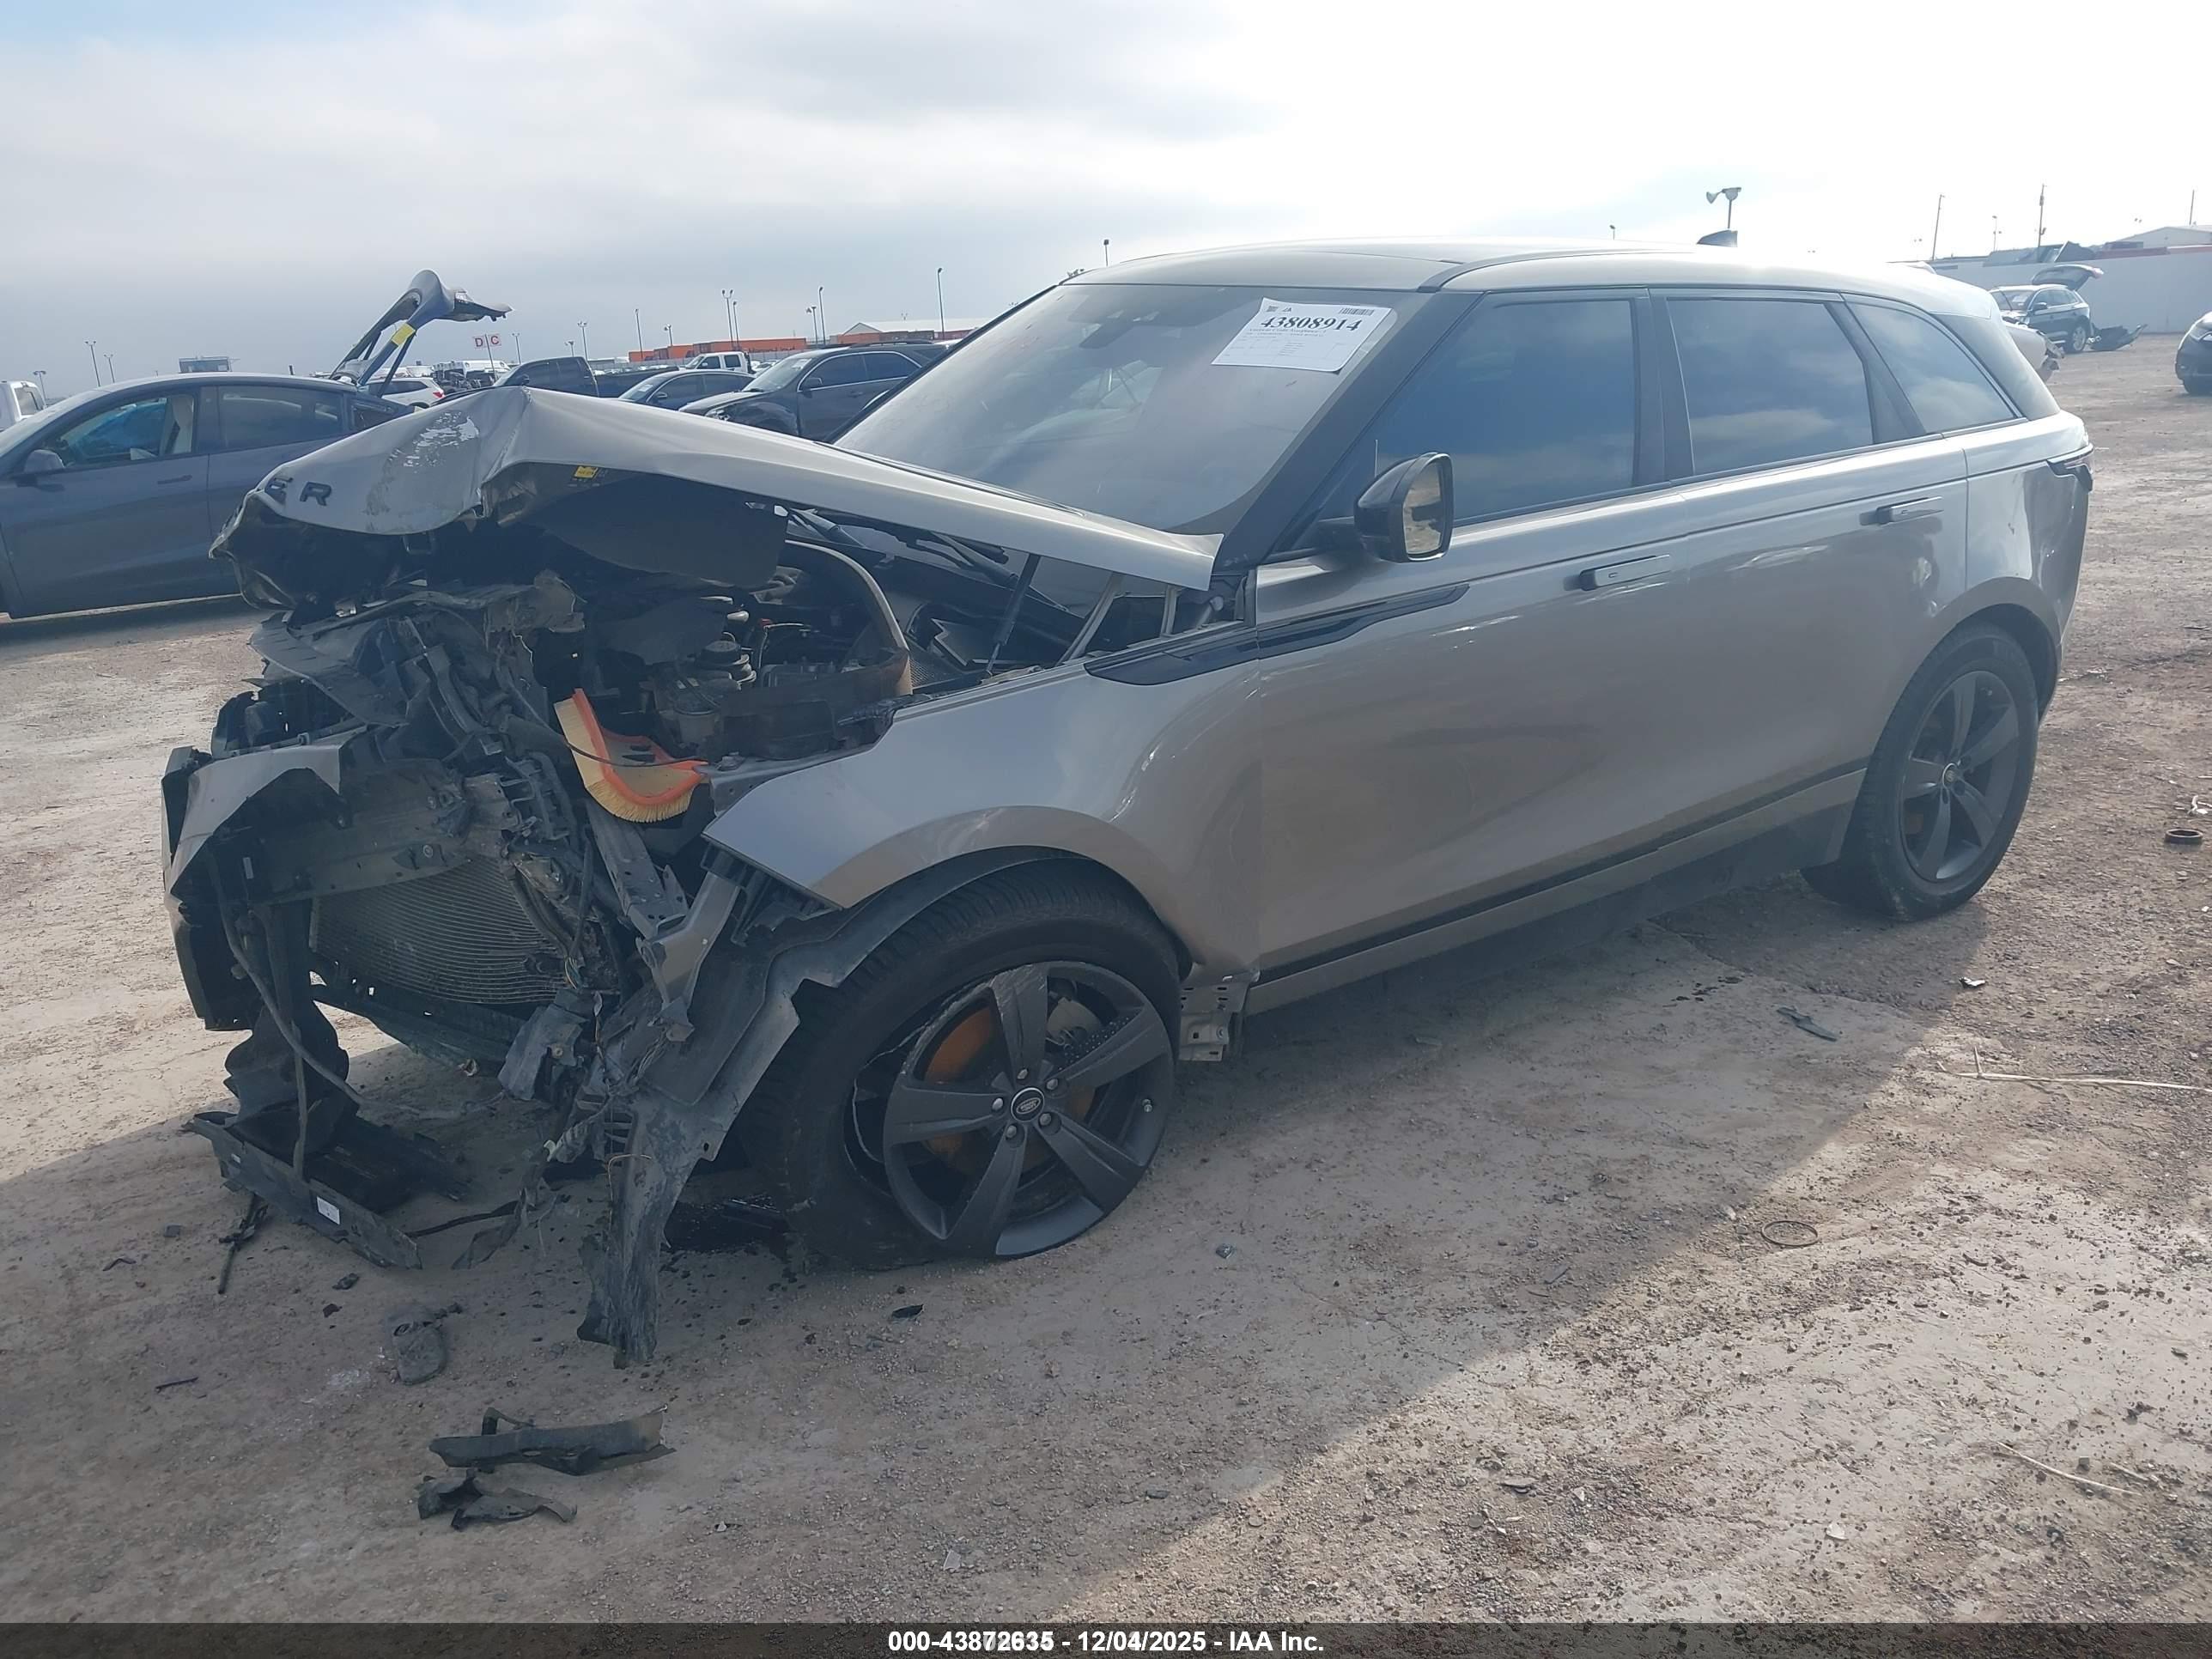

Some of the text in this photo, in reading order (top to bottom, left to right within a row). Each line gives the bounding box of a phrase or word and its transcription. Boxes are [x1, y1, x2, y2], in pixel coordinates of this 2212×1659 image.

[1261, 316, 1363, 331] 43808914
[475, 337, 483, 347] D
[490, 336, 500, 345] C
